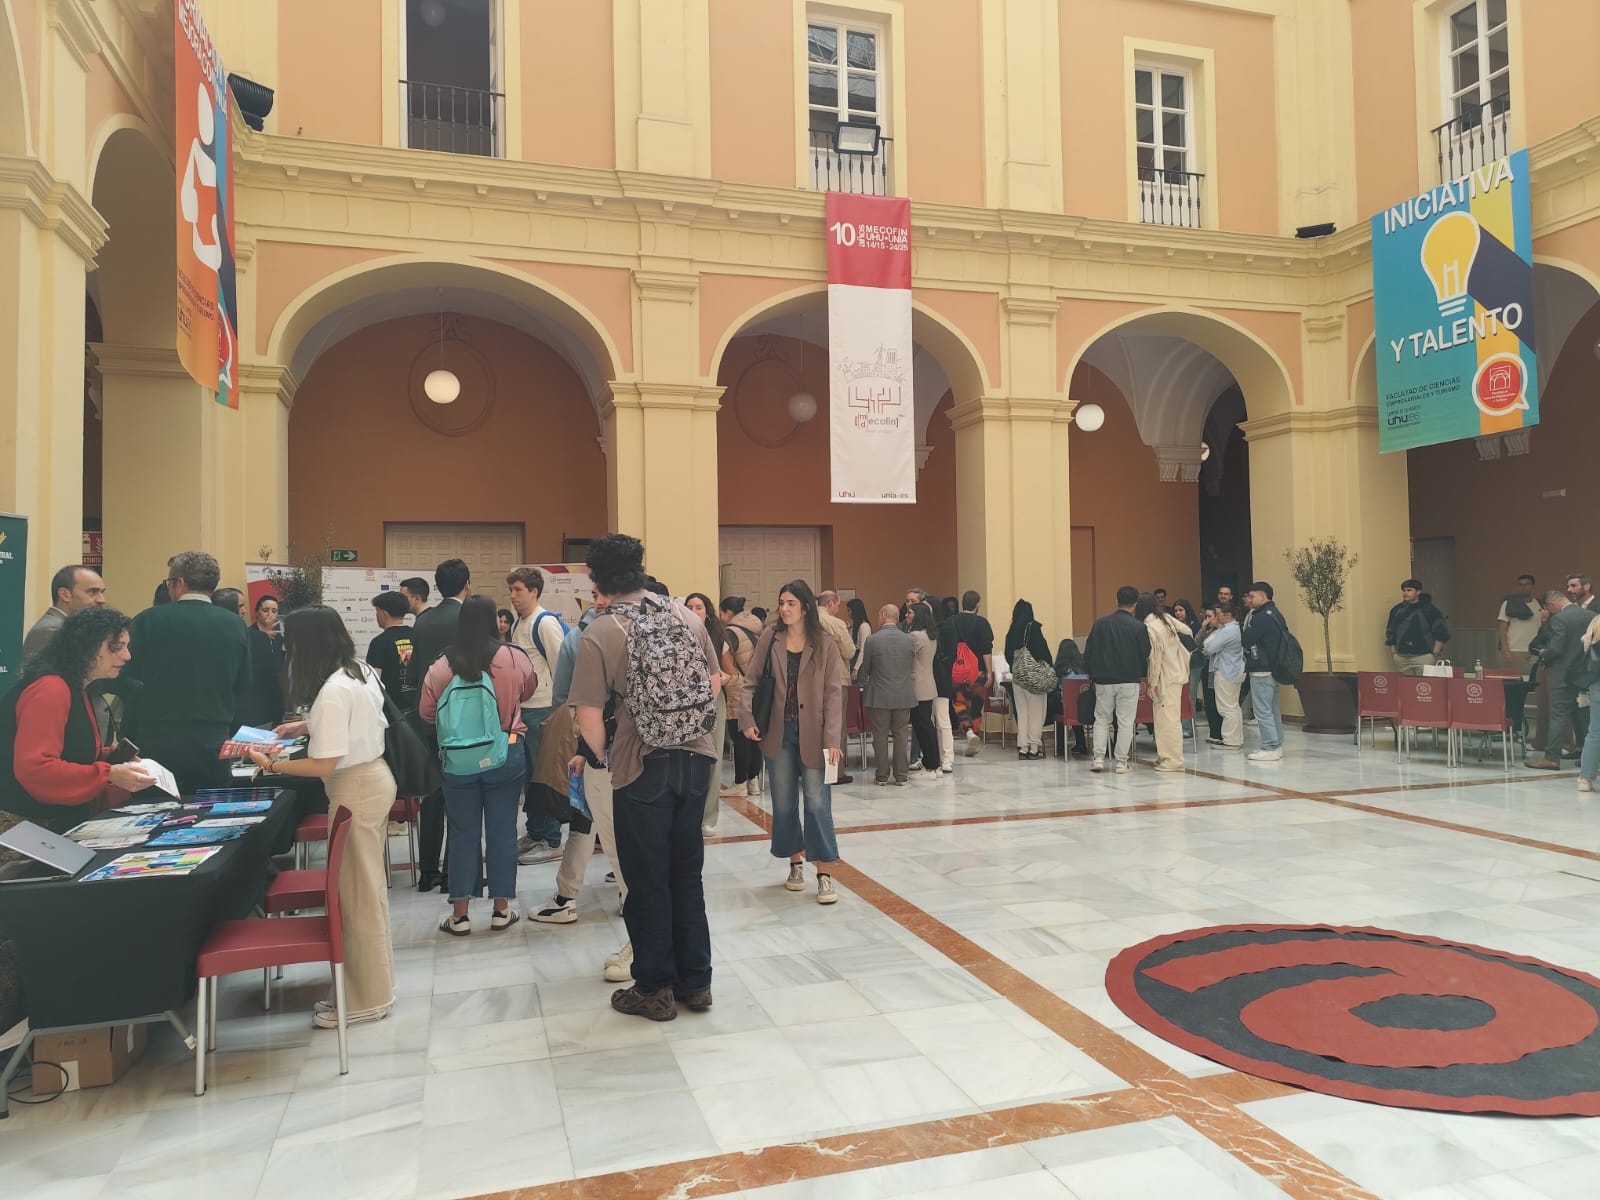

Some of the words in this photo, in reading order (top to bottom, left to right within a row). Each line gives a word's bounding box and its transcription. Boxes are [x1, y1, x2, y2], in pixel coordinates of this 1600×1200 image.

[1384, 158, 1514, 235] INICIATIVA
[830, 221, 856, 247] 10
[866, 225, 908, 236] MECOFIN
[1390, 337, 1405, 363] Y
[1408, 302, 1523, 357] TALENTO
[1386, 388, 1417, 400] FACULTAD
[1419, 385, 1428, 393] DE
[1429, 377, 1461, 390] CIENCIAS
